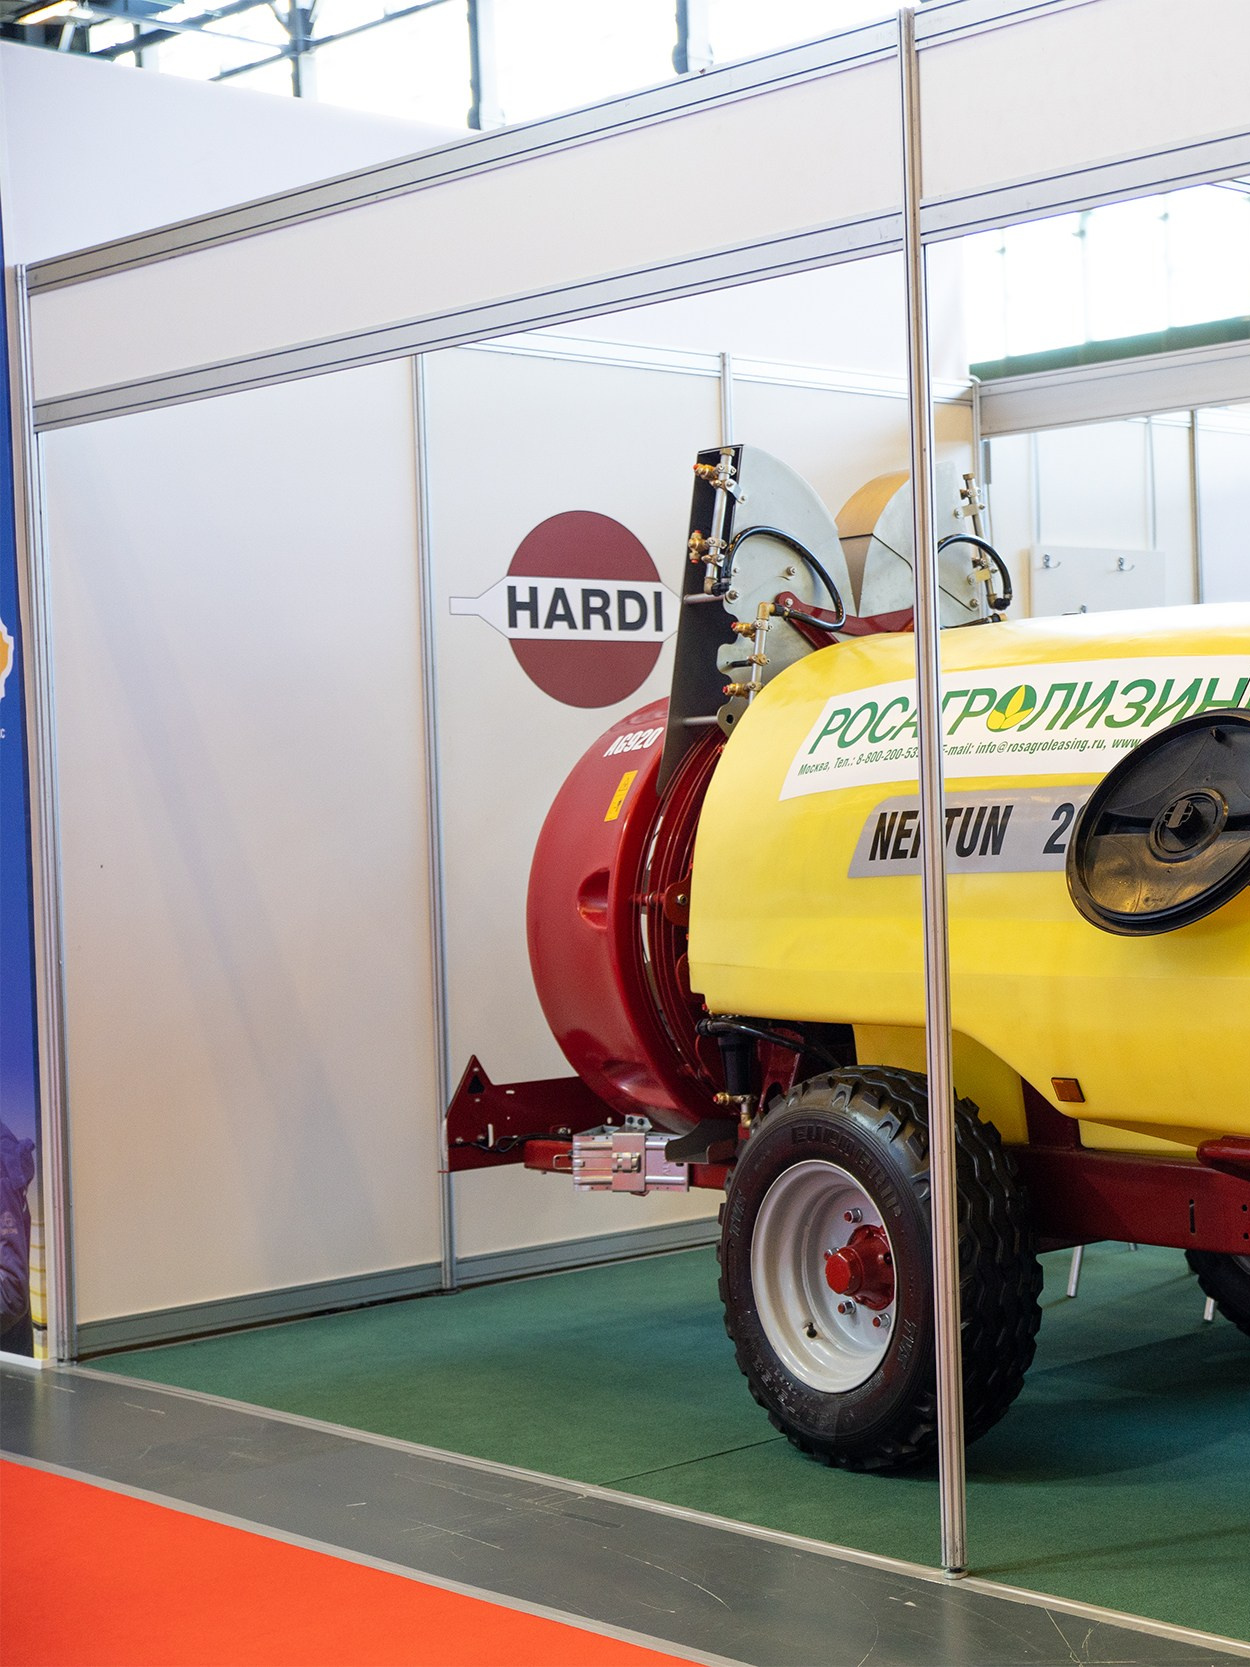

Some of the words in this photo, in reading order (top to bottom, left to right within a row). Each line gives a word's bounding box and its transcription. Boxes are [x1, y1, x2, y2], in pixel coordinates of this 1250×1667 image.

[507, 585, 664, 632] HARDI
[603, 727, 664, 757] AG920
[797, 761, 830, 776] Москва,
[856, 746, 919, 765] 8-800-200-53
[975, 738, 1106, 755] info@rosagroleasing.ru,
